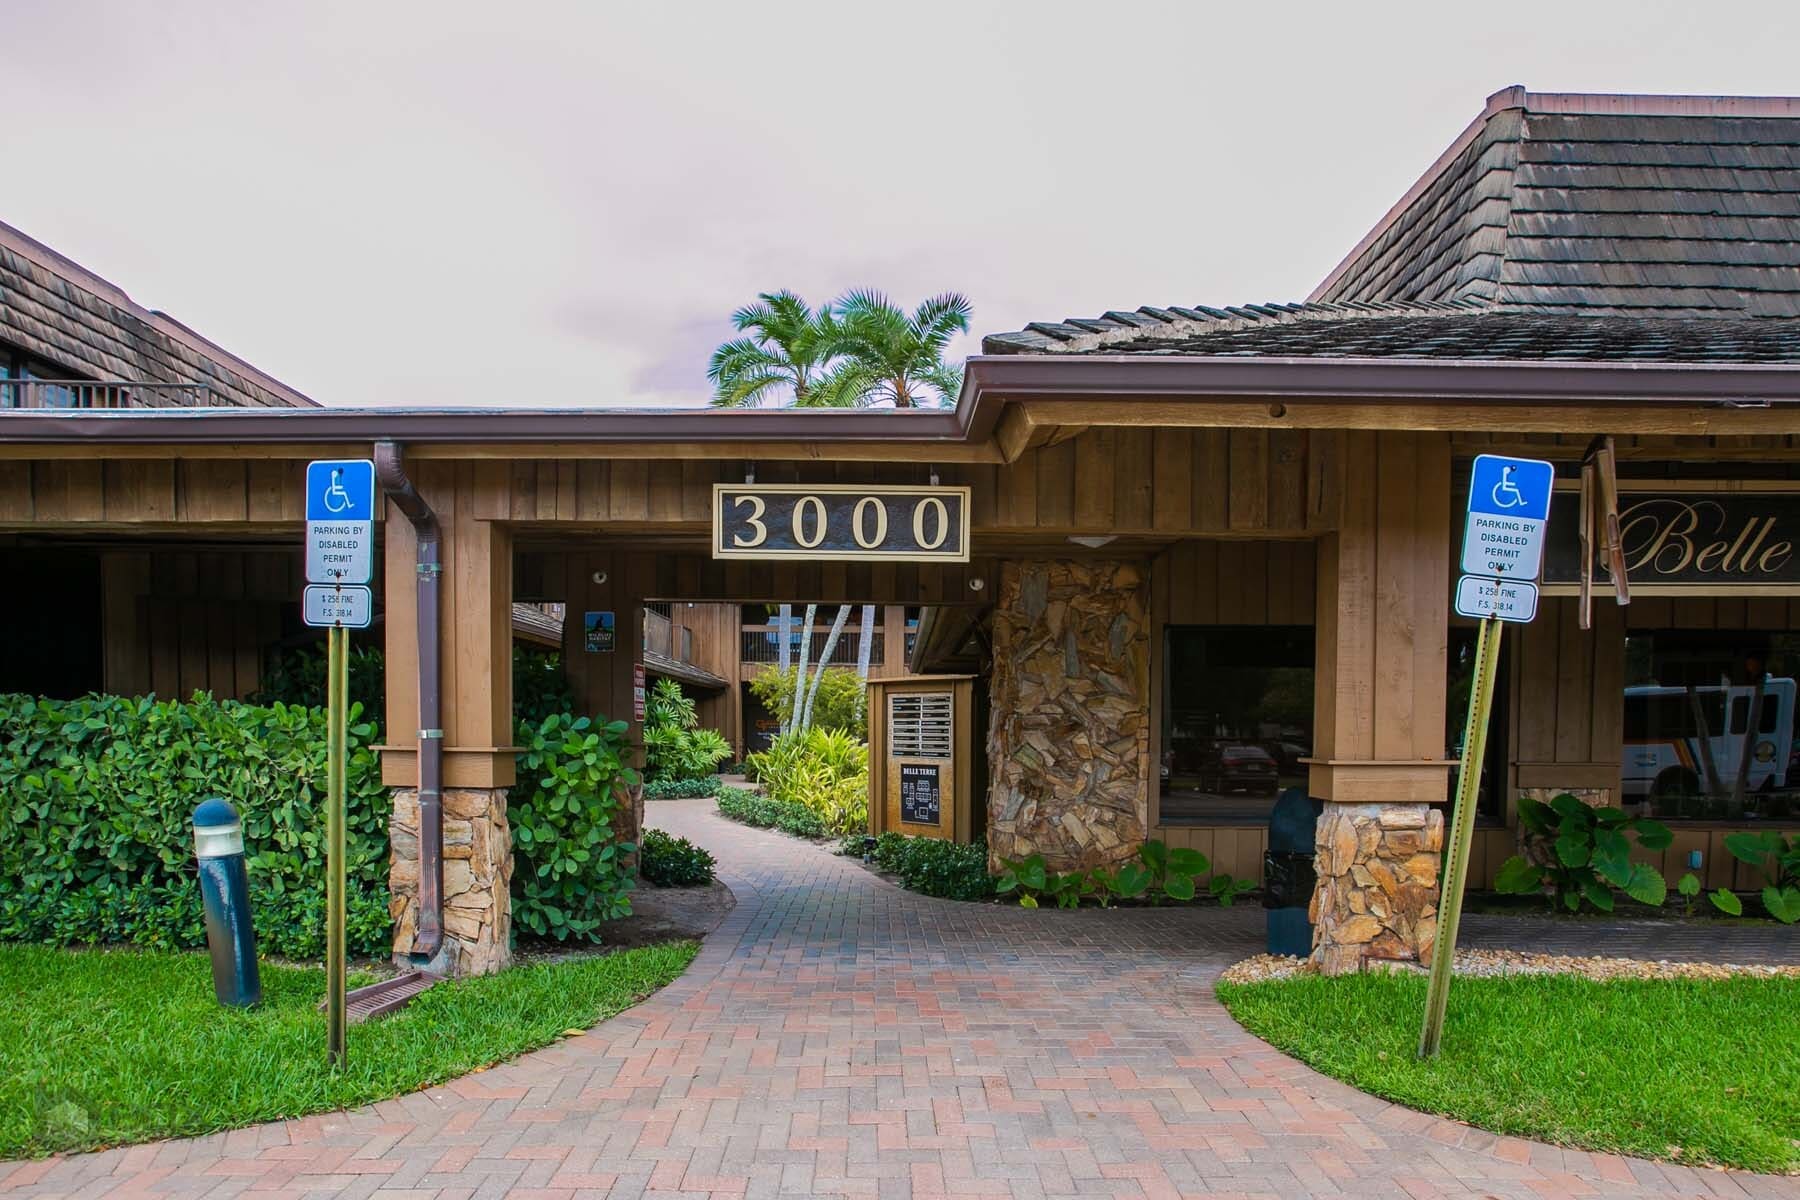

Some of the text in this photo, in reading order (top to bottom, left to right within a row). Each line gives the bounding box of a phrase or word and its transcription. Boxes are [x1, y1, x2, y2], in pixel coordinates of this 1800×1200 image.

[733, 495, 949, 550] 3000
[1476, 519, 1536, 533] PARKING BY
[313, 526, 364, 535] PARKING BY
[1480, 533, 1528, 546] DISABLED
[1600, 499, 1793, 574] Belle
[319, 540, 359, 549] DISABLED
[1484, 547, 1521, 558] PERMIT
[323, 554, 353, 563] PERMIT
[1487, 561, 1514, 571] ONLY
[327, 568, 349, 577] ONLY
[1500, 589, 1517, 598] FINE
[341, 595, 354, 604] FINE
[903, 767, 919, 775] BELLE
